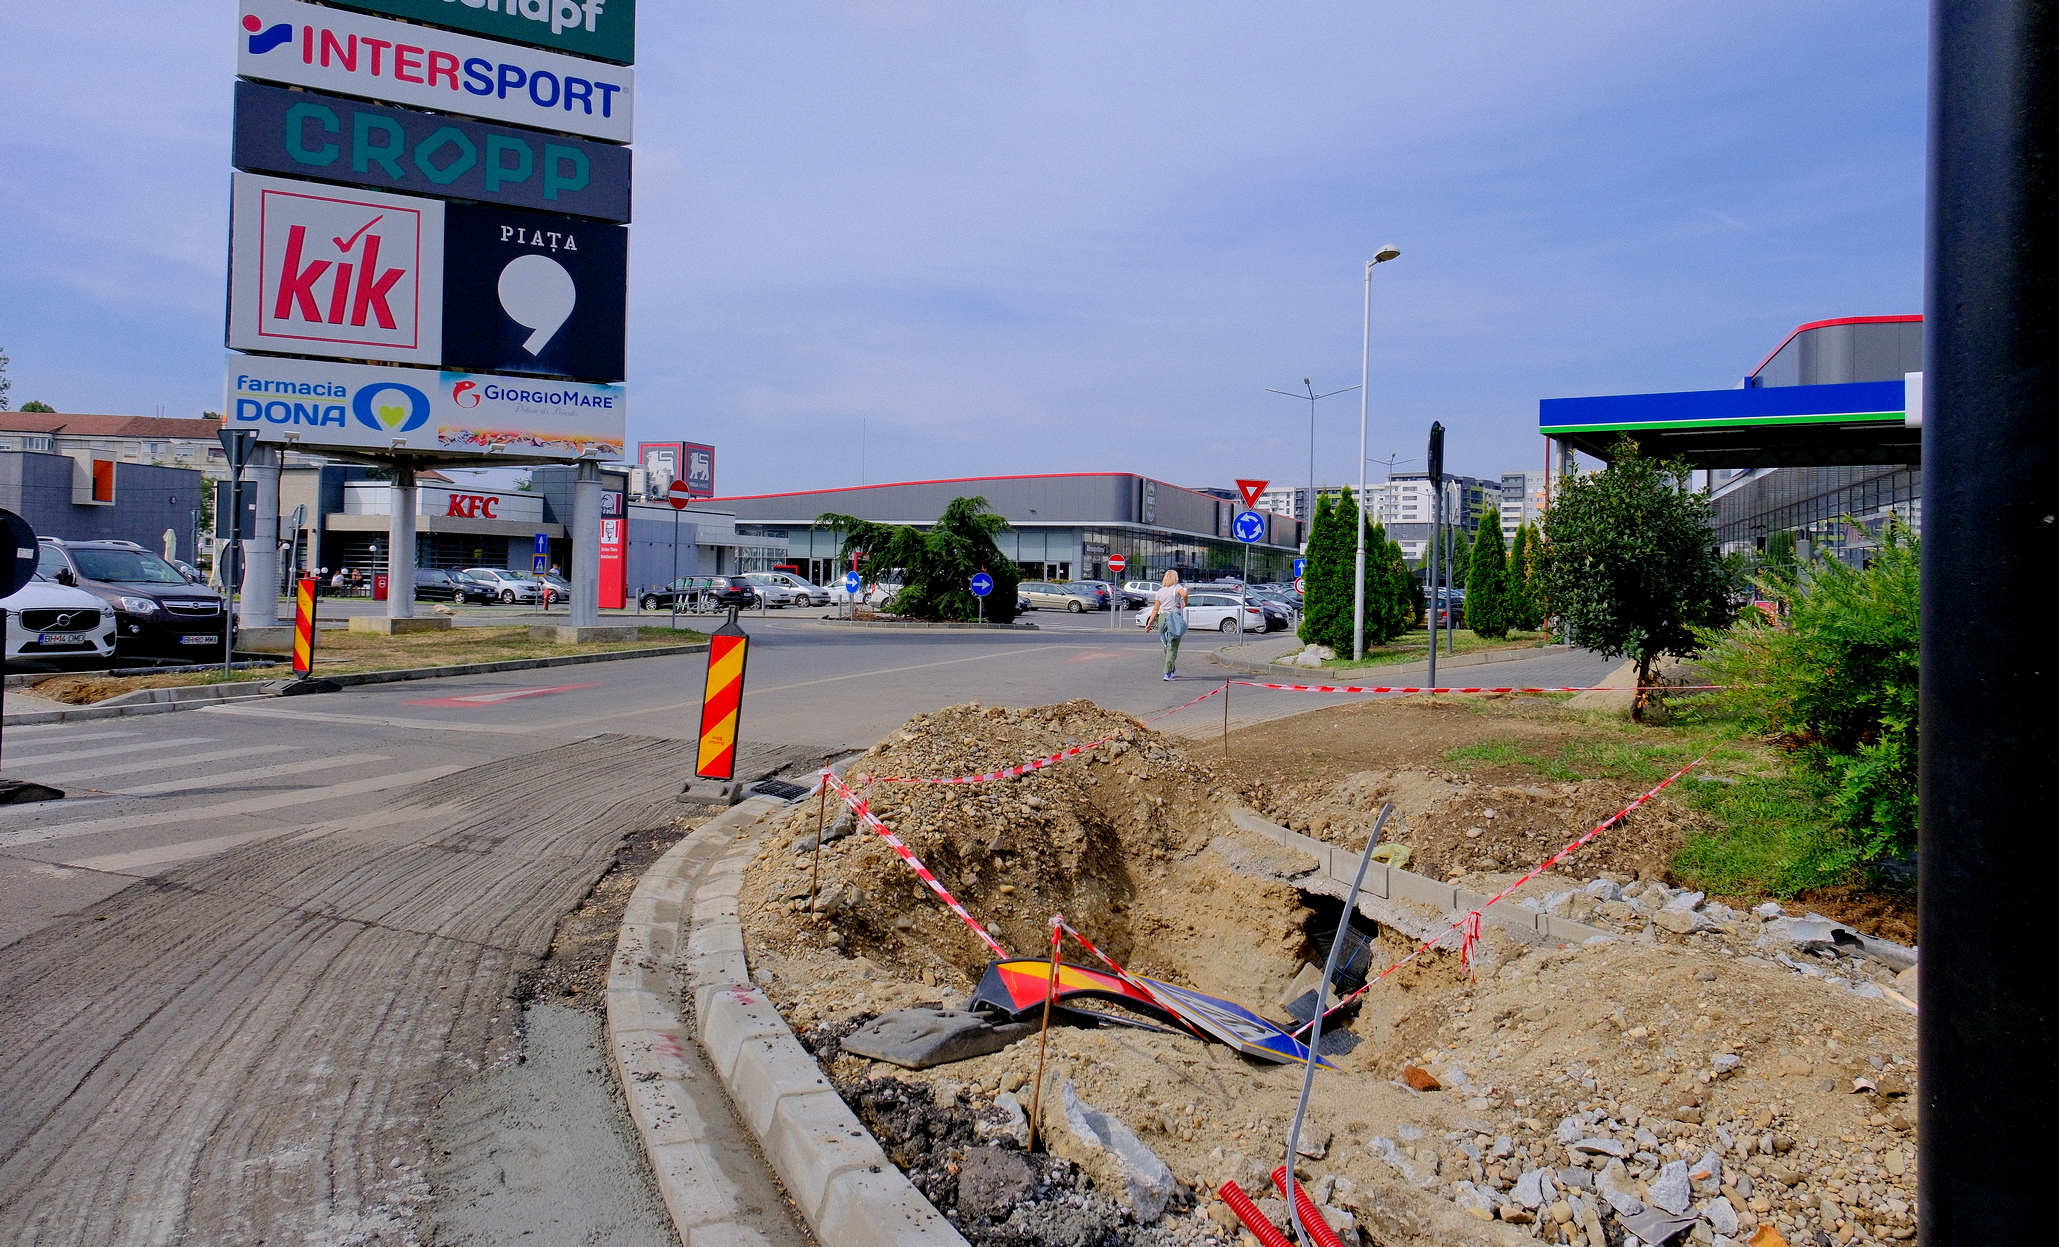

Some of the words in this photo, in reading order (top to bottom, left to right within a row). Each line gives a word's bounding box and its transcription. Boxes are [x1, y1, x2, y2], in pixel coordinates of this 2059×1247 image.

[302, 25, 621, 118] INTERSPORT
[285, 102, 591, 201] CROPP
[500, 225, 578, 253] PIAȚA
[273, 215, 407, 330] kik
[497, 254, 576, 357] 9
[236, 398, 346, 428] DONA
[237, 375, 347, 398] farmacia
[445, 493, 500, 519] KFC
